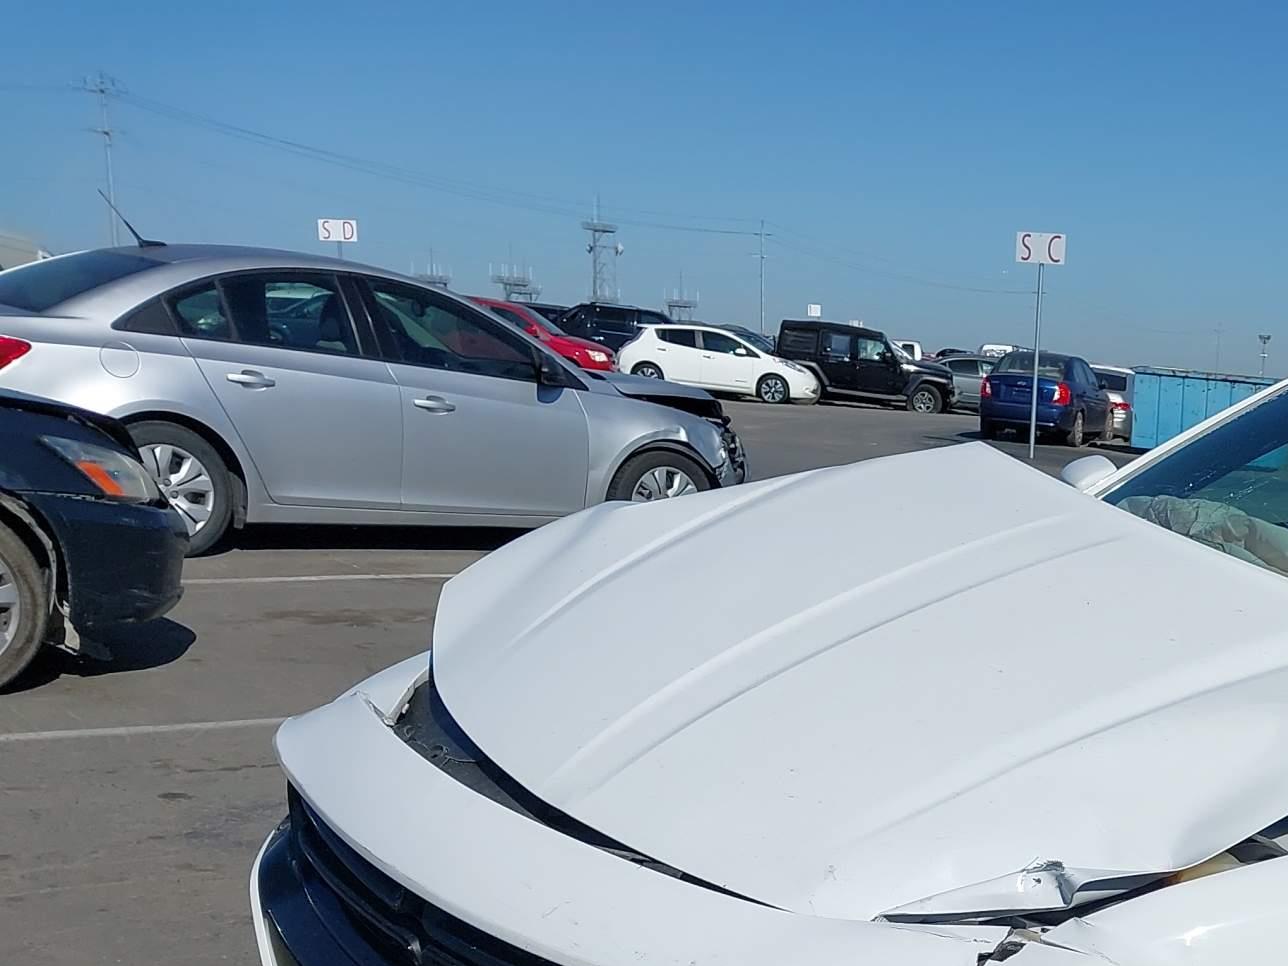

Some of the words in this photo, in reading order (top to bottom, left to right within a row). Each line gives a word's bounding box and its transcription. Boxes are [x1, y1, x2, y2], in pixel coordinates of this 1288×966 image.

[342, 221, 354, 240] D
[1021, 233, 1032, 261] S
[1047, 235, 1062, 263] C
